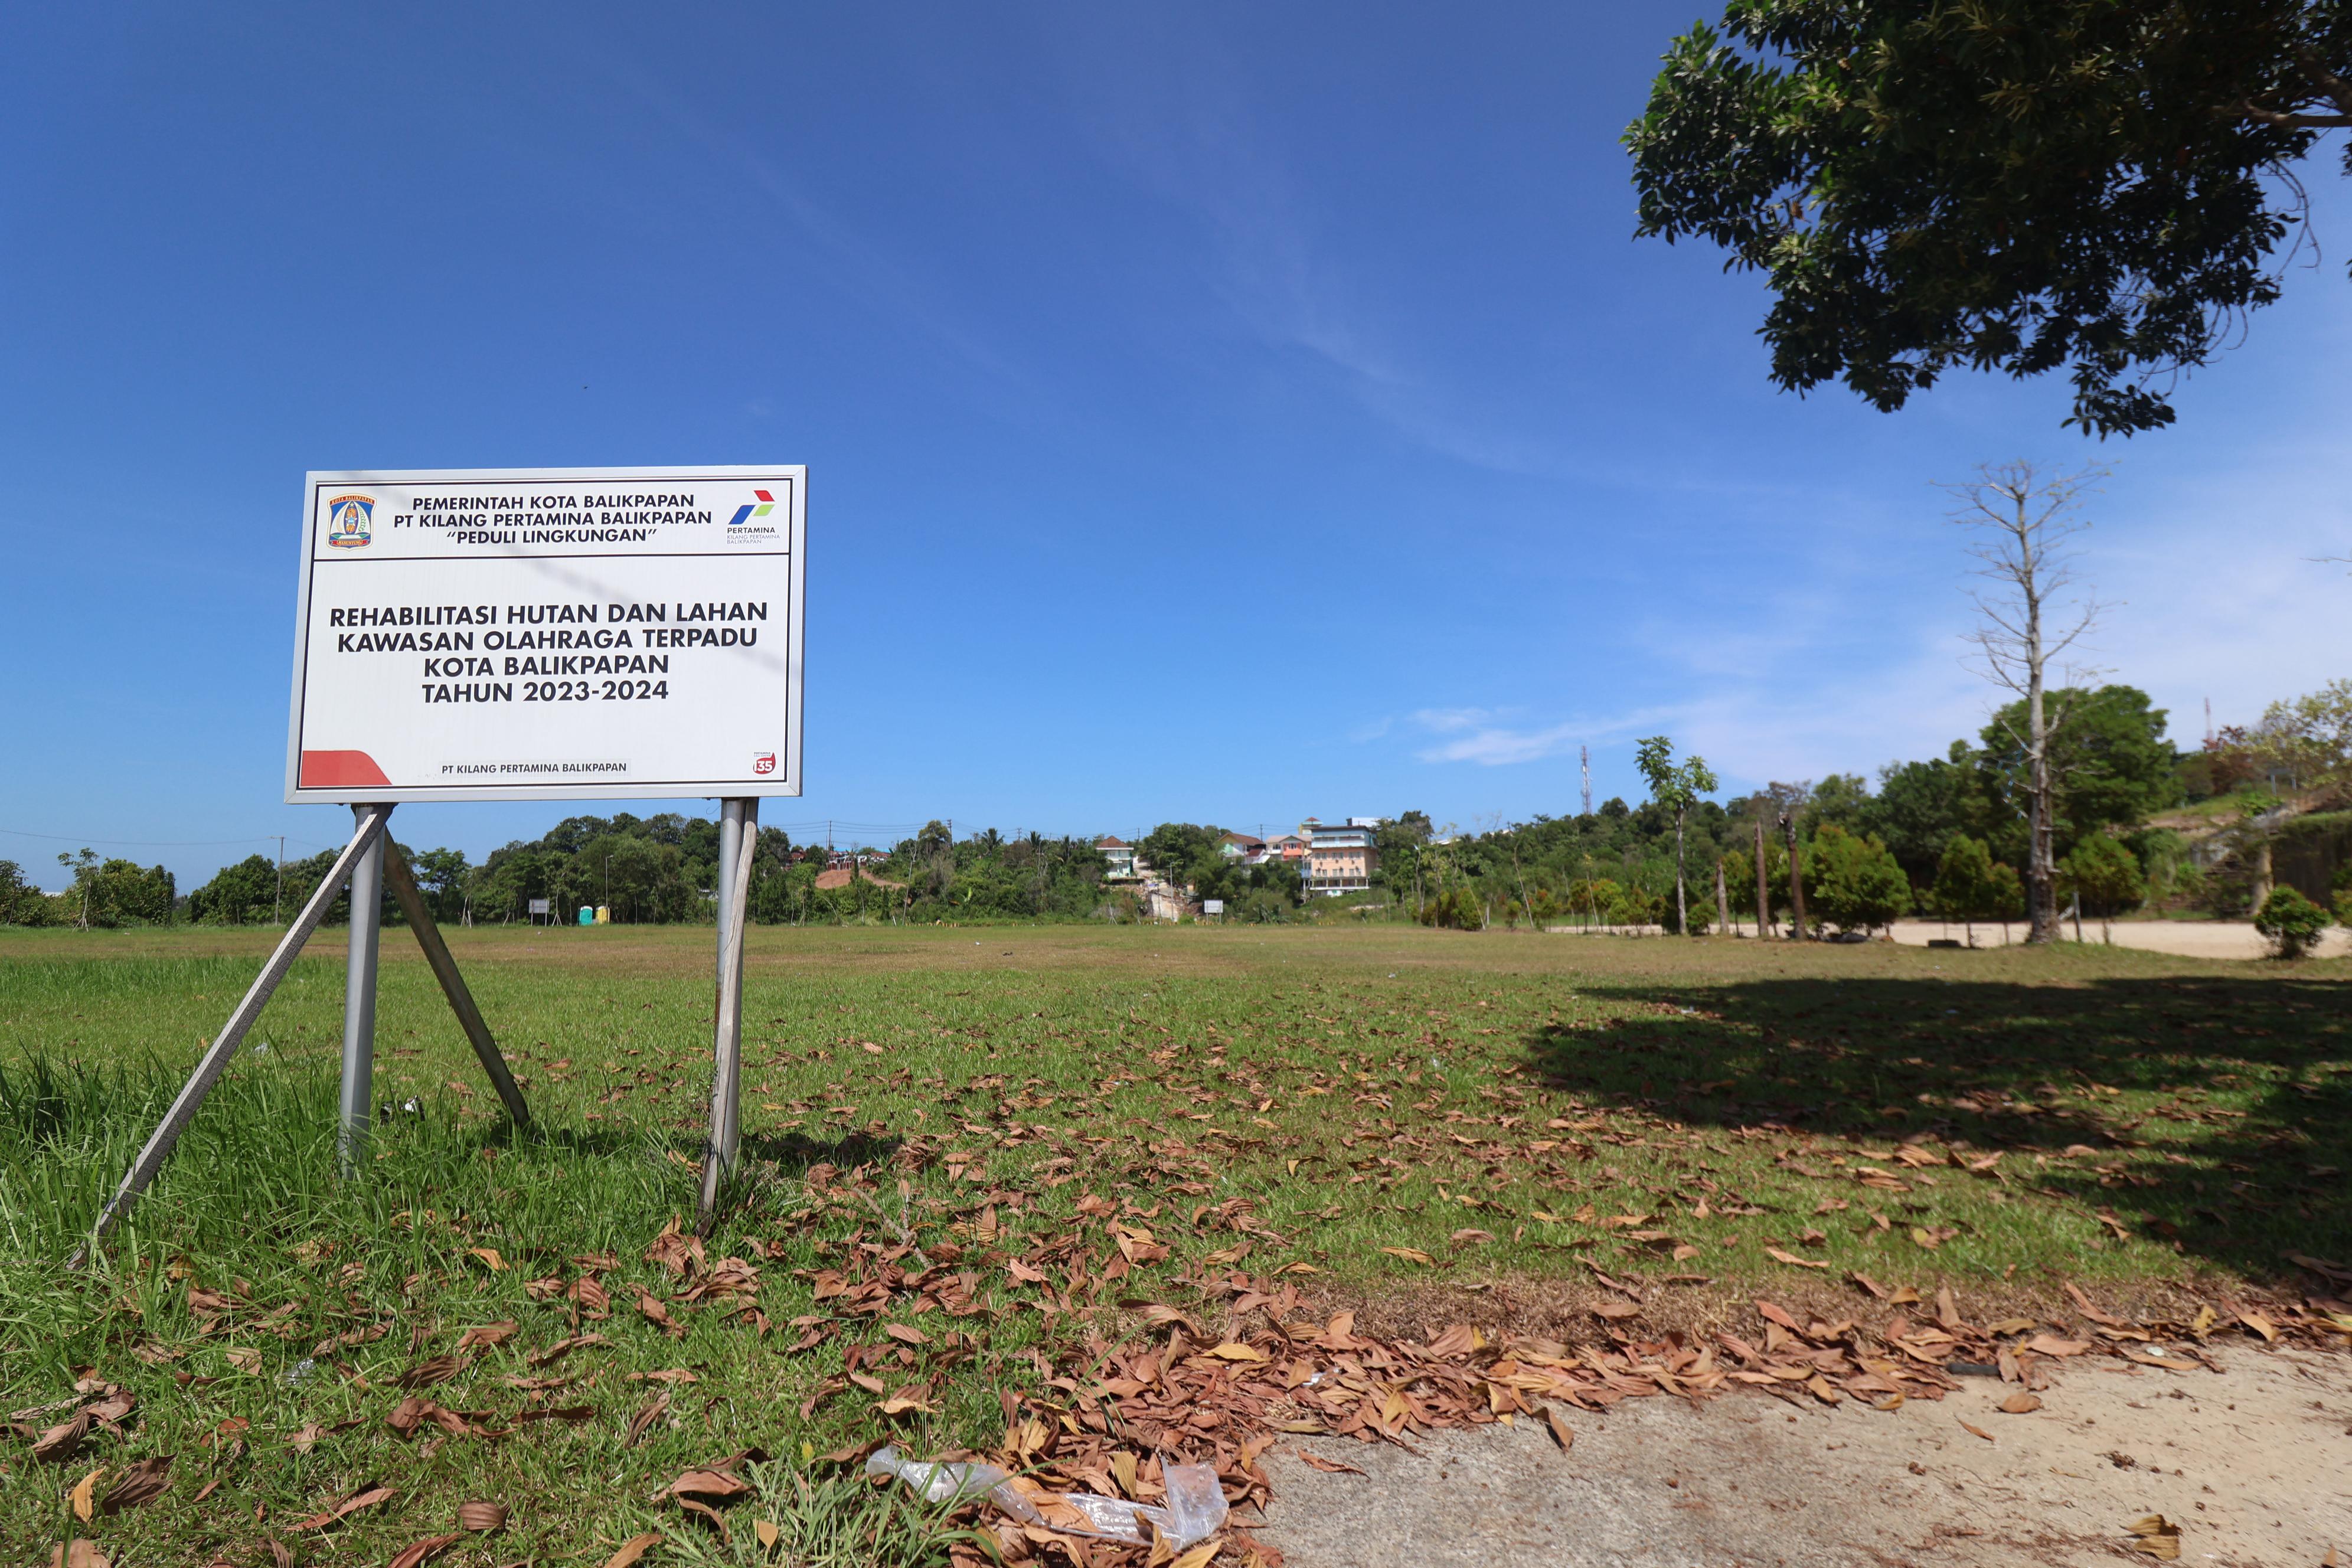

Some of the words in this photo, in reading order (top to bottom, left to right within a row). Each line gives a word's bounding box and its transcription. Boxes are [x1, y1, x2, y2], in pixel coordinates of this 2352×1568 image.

[413, 496, 523, 510] PEMERINTAH
[530, 496, 577, 509] KOTA
[583, 495, 694, 508] BALIKPAPAN
[394, 515, 413, 528] PT
[419, 514, 487, 527] KILANG
[494, 512, 594, 526] PERTAMINA
[601, 511, 711, 525] BALIKPAPAN
[330, 606, 497, 626] REHABILITASI
[507, 604, 597, 624] HUTAN
[608, 603, 666, 622] DAN
[676, 602, 767, 621] LAHAN
[338, 632, 473, 652] KAWASAN
[483, 629, 633, 651] OLAHRAGA
[642, 628, 757, 648] TERPADU
[424, 657, 495, 677] KOTA
[504, 655, 669, 676] BALIKPAPAN
[422, 682, 512, 703] TAHUN
[523, 680, 669, 701] 2023-2024
[442, 765, 454, 774] PT
[456, 765, 497, 773] KILANG
[499, 763, 559, 773] PERTAMINA
[562, 763, 627, 772] BALIKPAPAN
